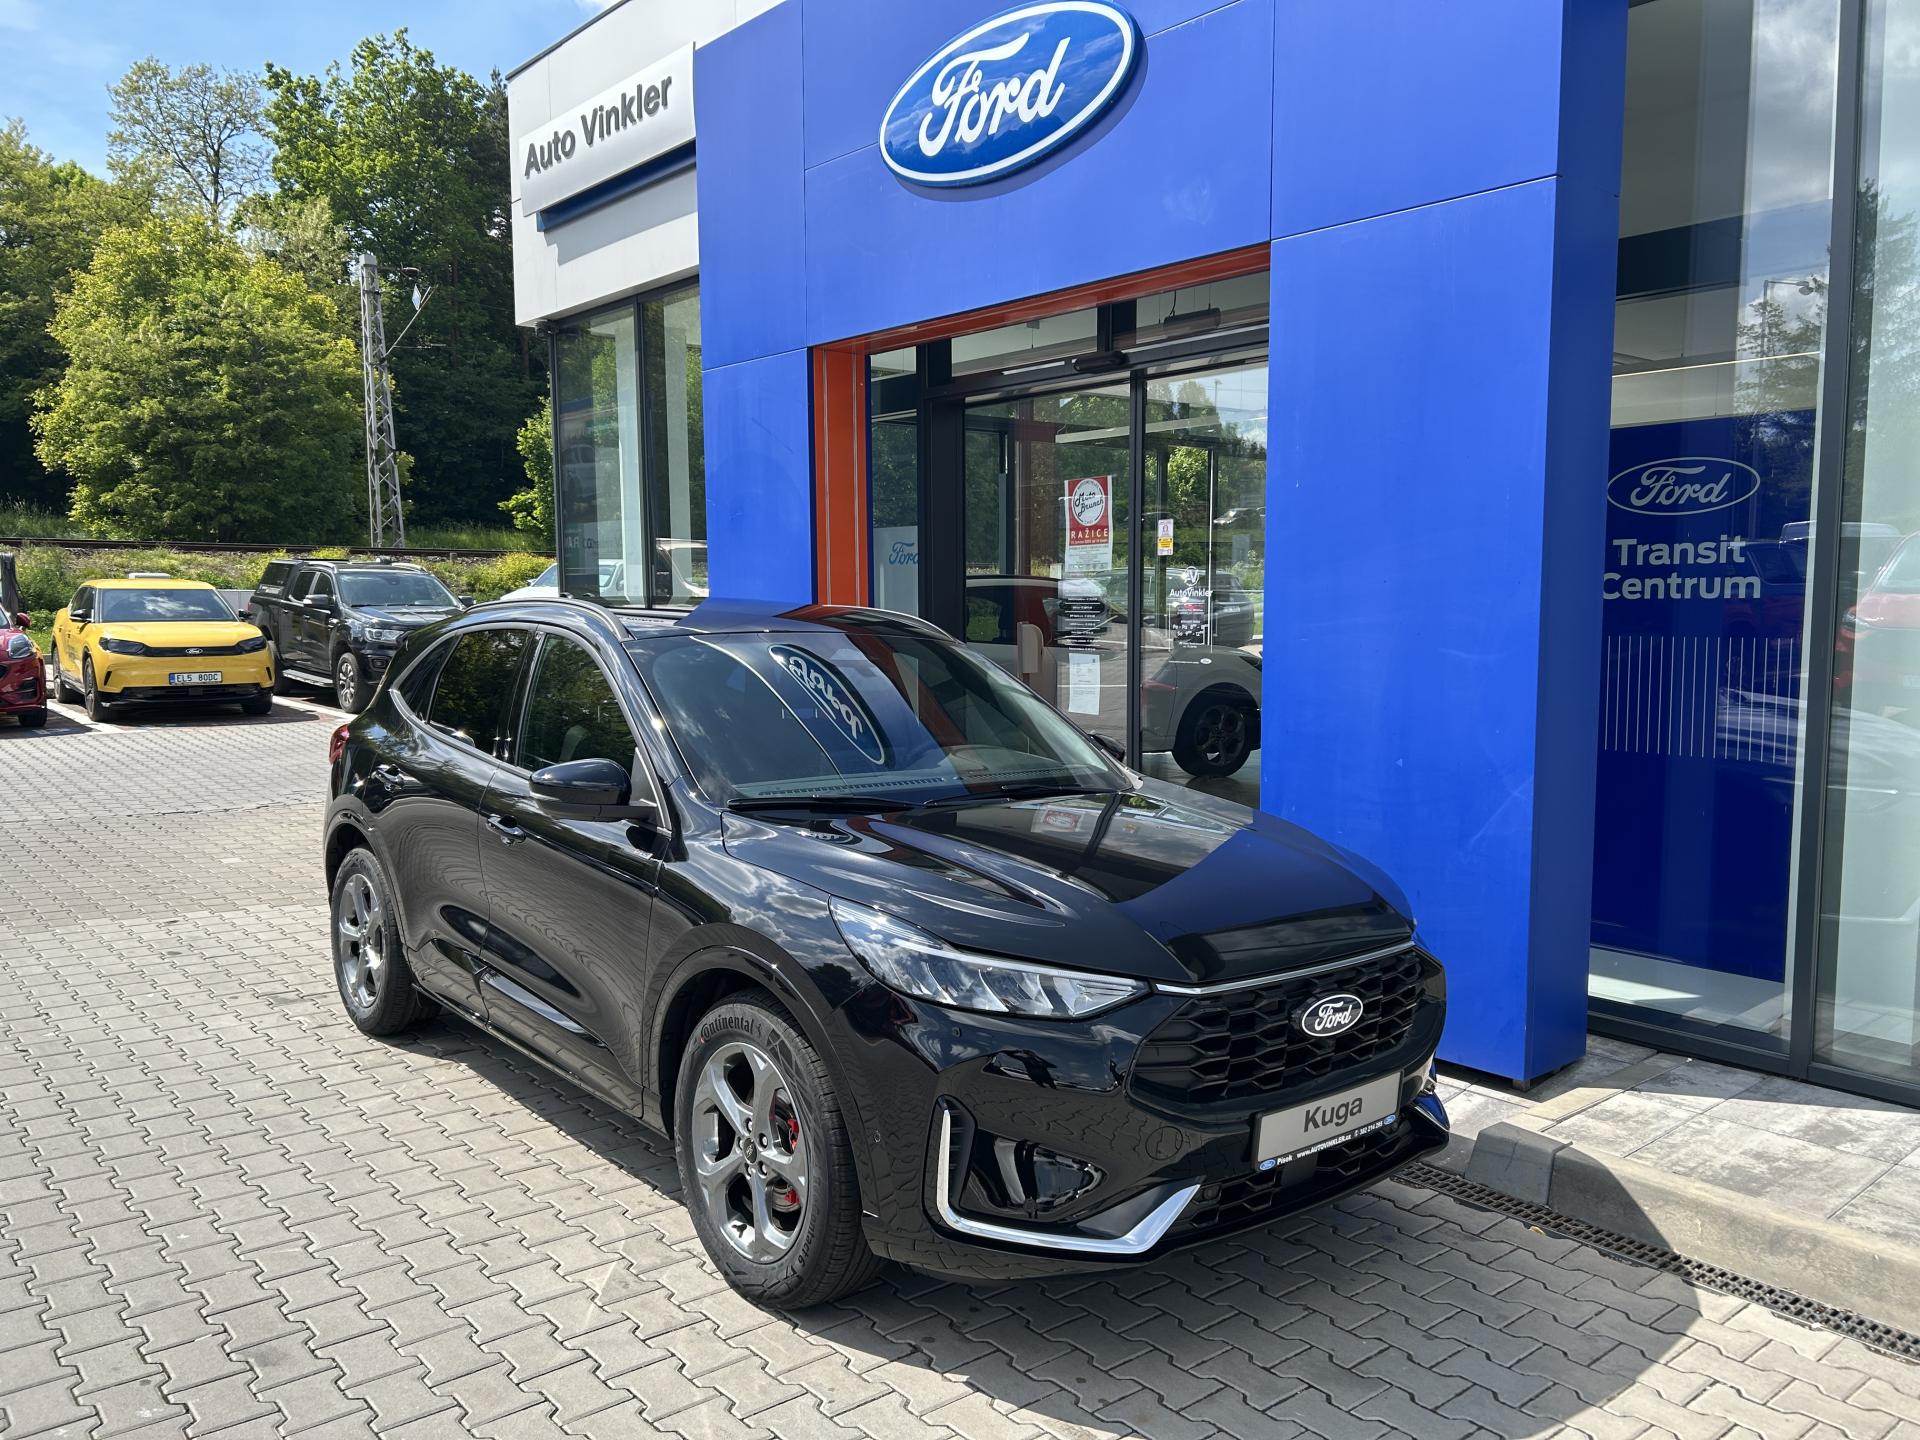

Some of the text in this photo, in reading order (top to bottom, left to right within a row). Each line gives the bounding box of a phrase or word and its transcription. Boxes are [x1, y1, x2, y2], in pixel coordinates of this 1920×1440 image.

[918, 32, 1070, 157] Ford
[525, 76, 672, 179] Auto Vinkler
[1630, 465, 1732, 507] Ford
[1078, 499, 1104, 517] Brunch
[1071, 528, 1109, 540] RAŽICE
[1613, 534, 1746, 566] Transit
[1601, 571, 1761, 601] Centrum
[701, 1015, 754, 1038] Continental
[1314, 1001, 1352, 1031] Ford
[1303, 1097, 1363, 1133] Kuga
